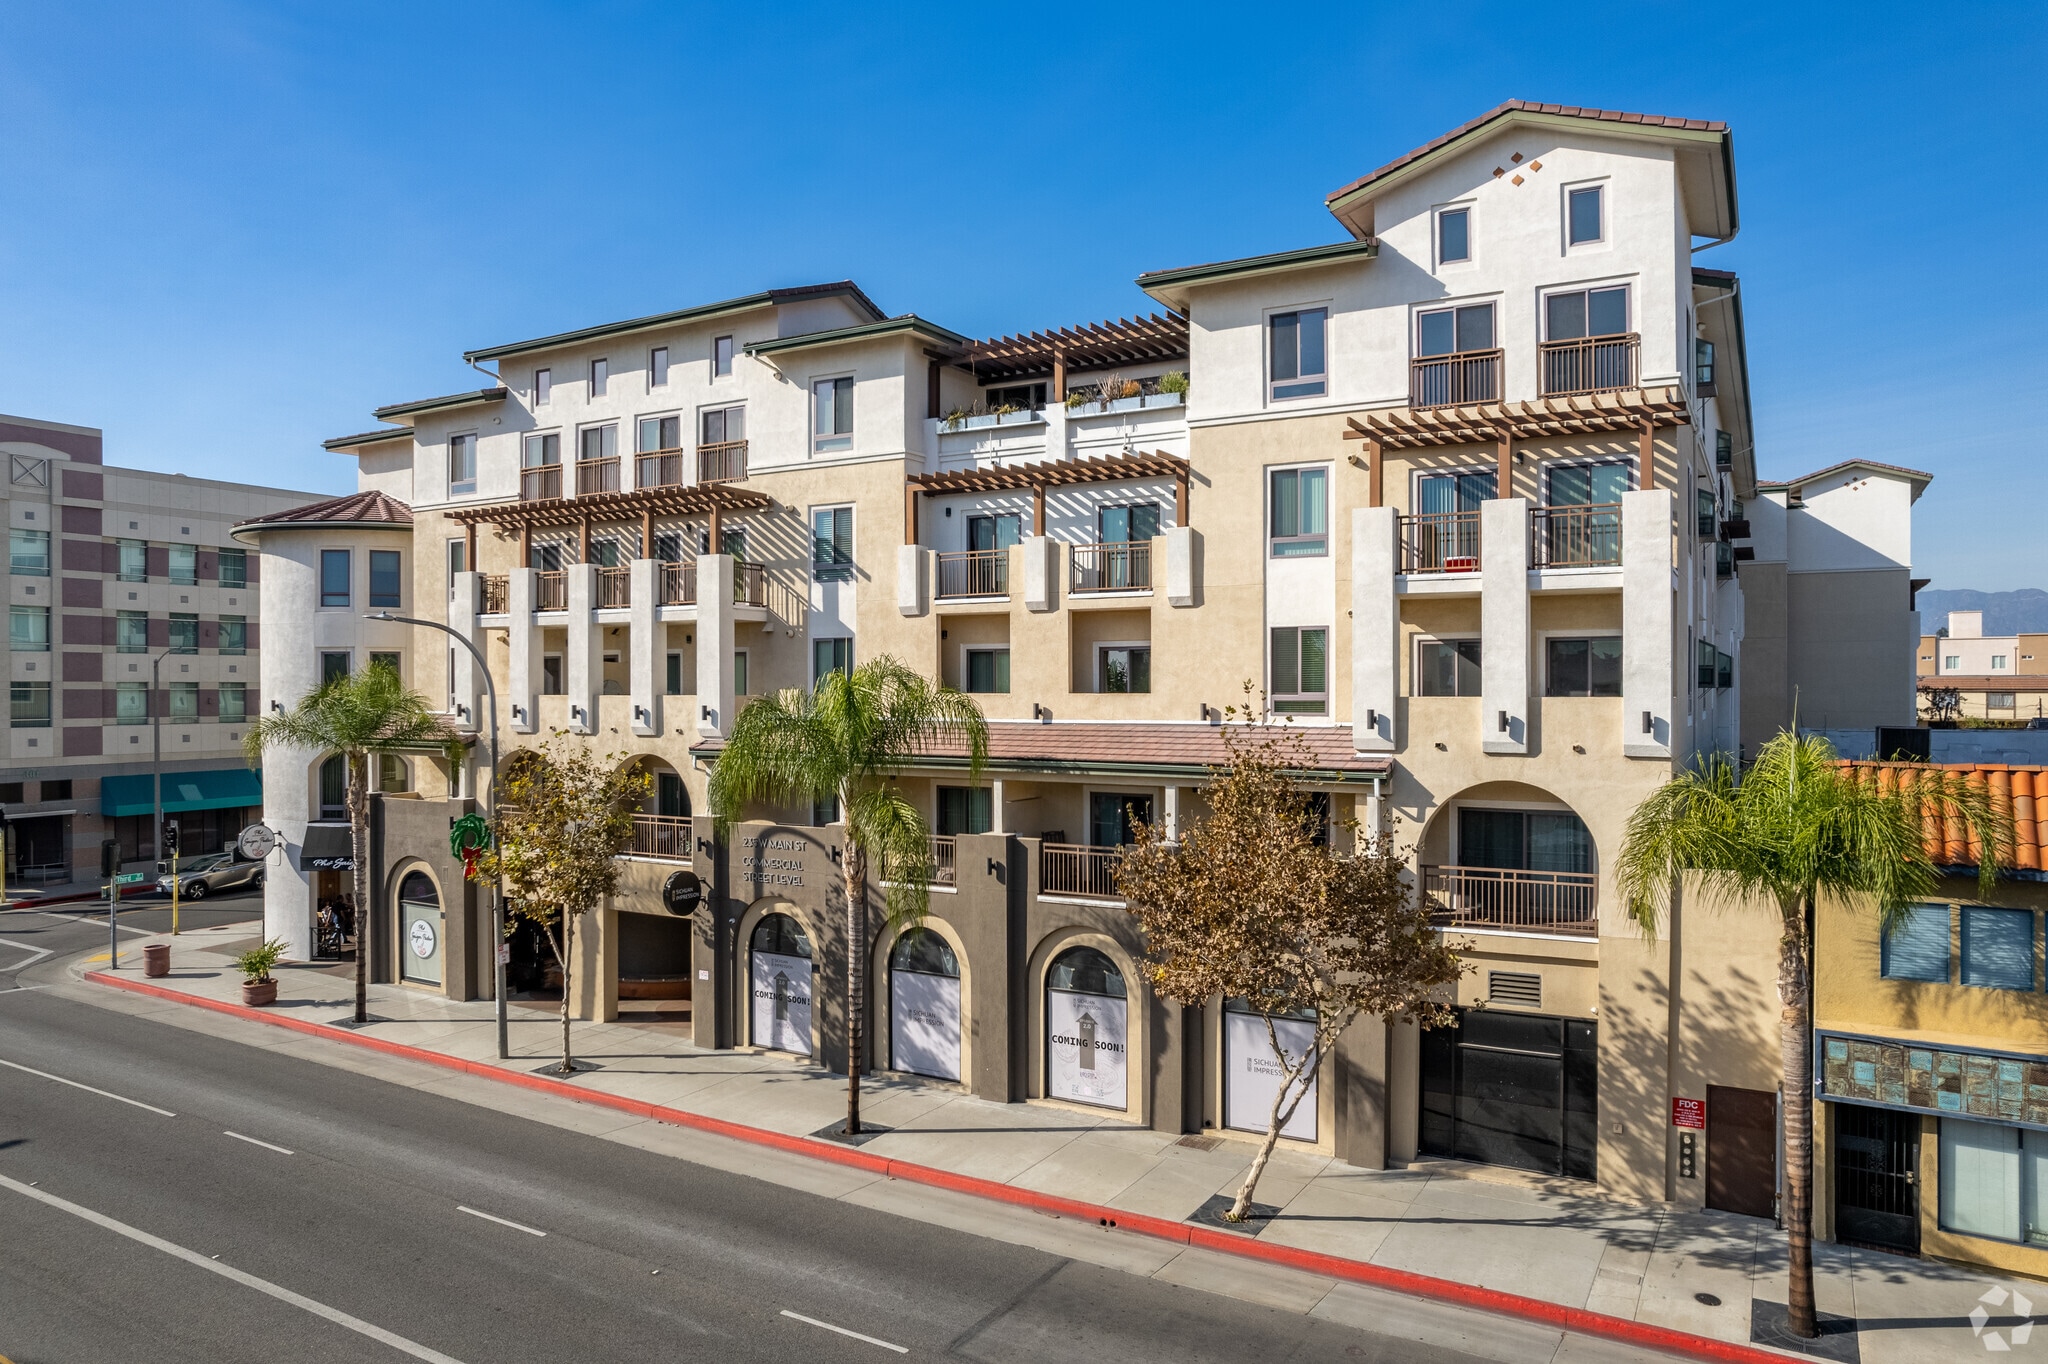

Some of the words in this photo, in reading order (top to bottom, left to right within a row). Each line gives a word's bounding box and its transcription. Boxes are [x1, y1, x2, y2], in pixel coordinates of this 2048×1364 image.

[760, 839, 769, 848] W
[769, 840, 795, 851] MAIN
[794, 841, 808, 852] ST
[742, 856, 804, 871] COMMERCIAL
[743, 871, 775, 884] STREET
[776, 874, 804, 887] LEVEL
[676, 892, 700, 901] IMPRESSION
[755, 990, 783, 1002] COMING
[787, 995, 811, 1006] SOON!
[913, 1009, 936, 1019] SICHUAN
[913, 1017, 945, 1027] IMPRESSION
[1052, 1034, 1089, 1048] COMING
[1094, 1040, 1125, 1053] SOON!
[1253, 1058, 1281, 1068] SICHUA
[1679, 1099, 1699, 1110] FDC
